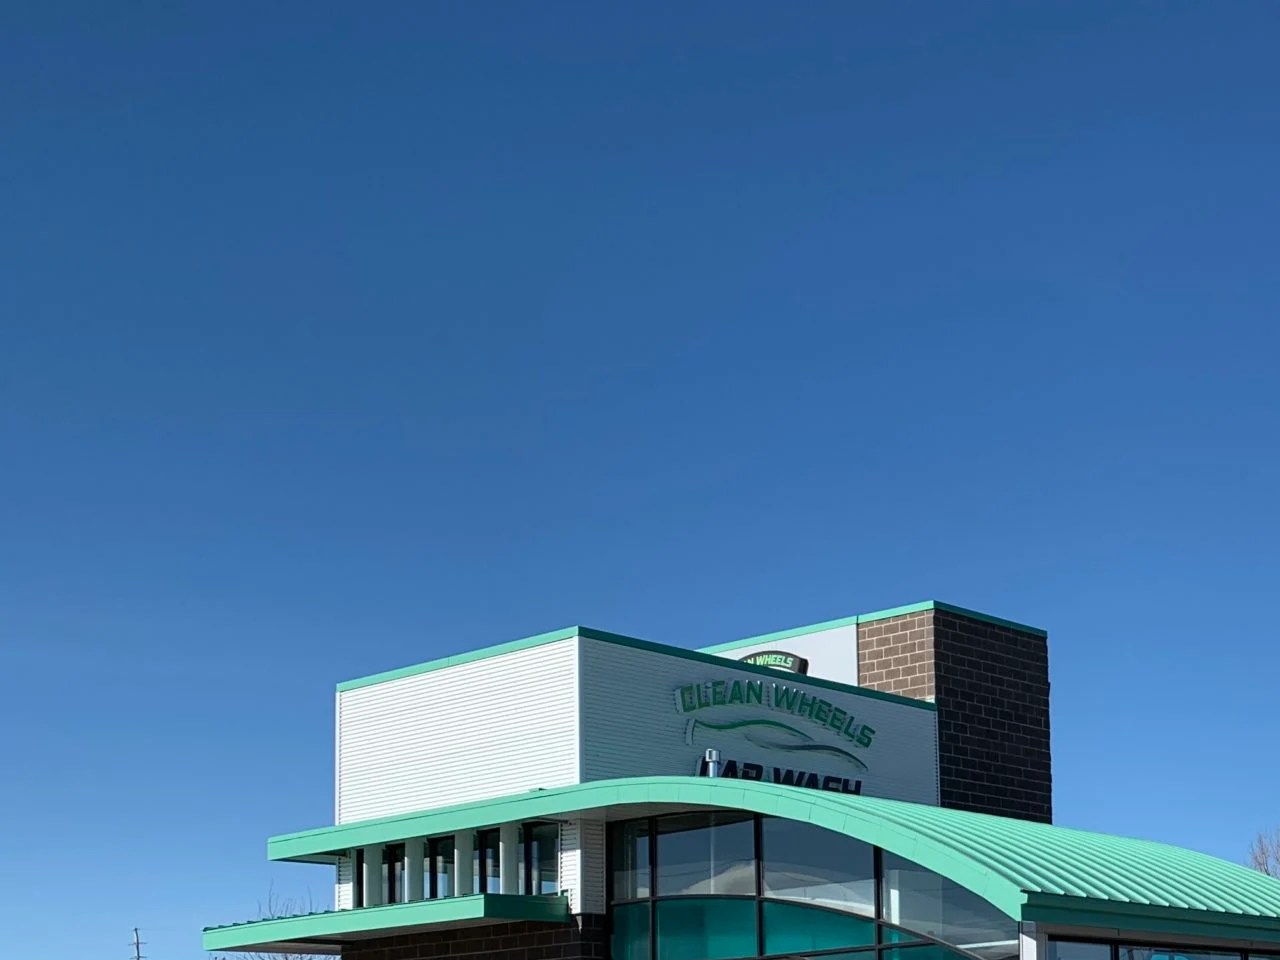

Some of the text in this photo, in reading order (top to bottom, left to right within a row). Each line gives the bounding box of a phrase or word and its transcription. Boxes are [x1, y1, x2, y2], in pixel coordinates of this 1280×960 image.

[755, 654, 794, 668] WHEELS
[677, 679, 876, 748] CLEAN WHEELS
